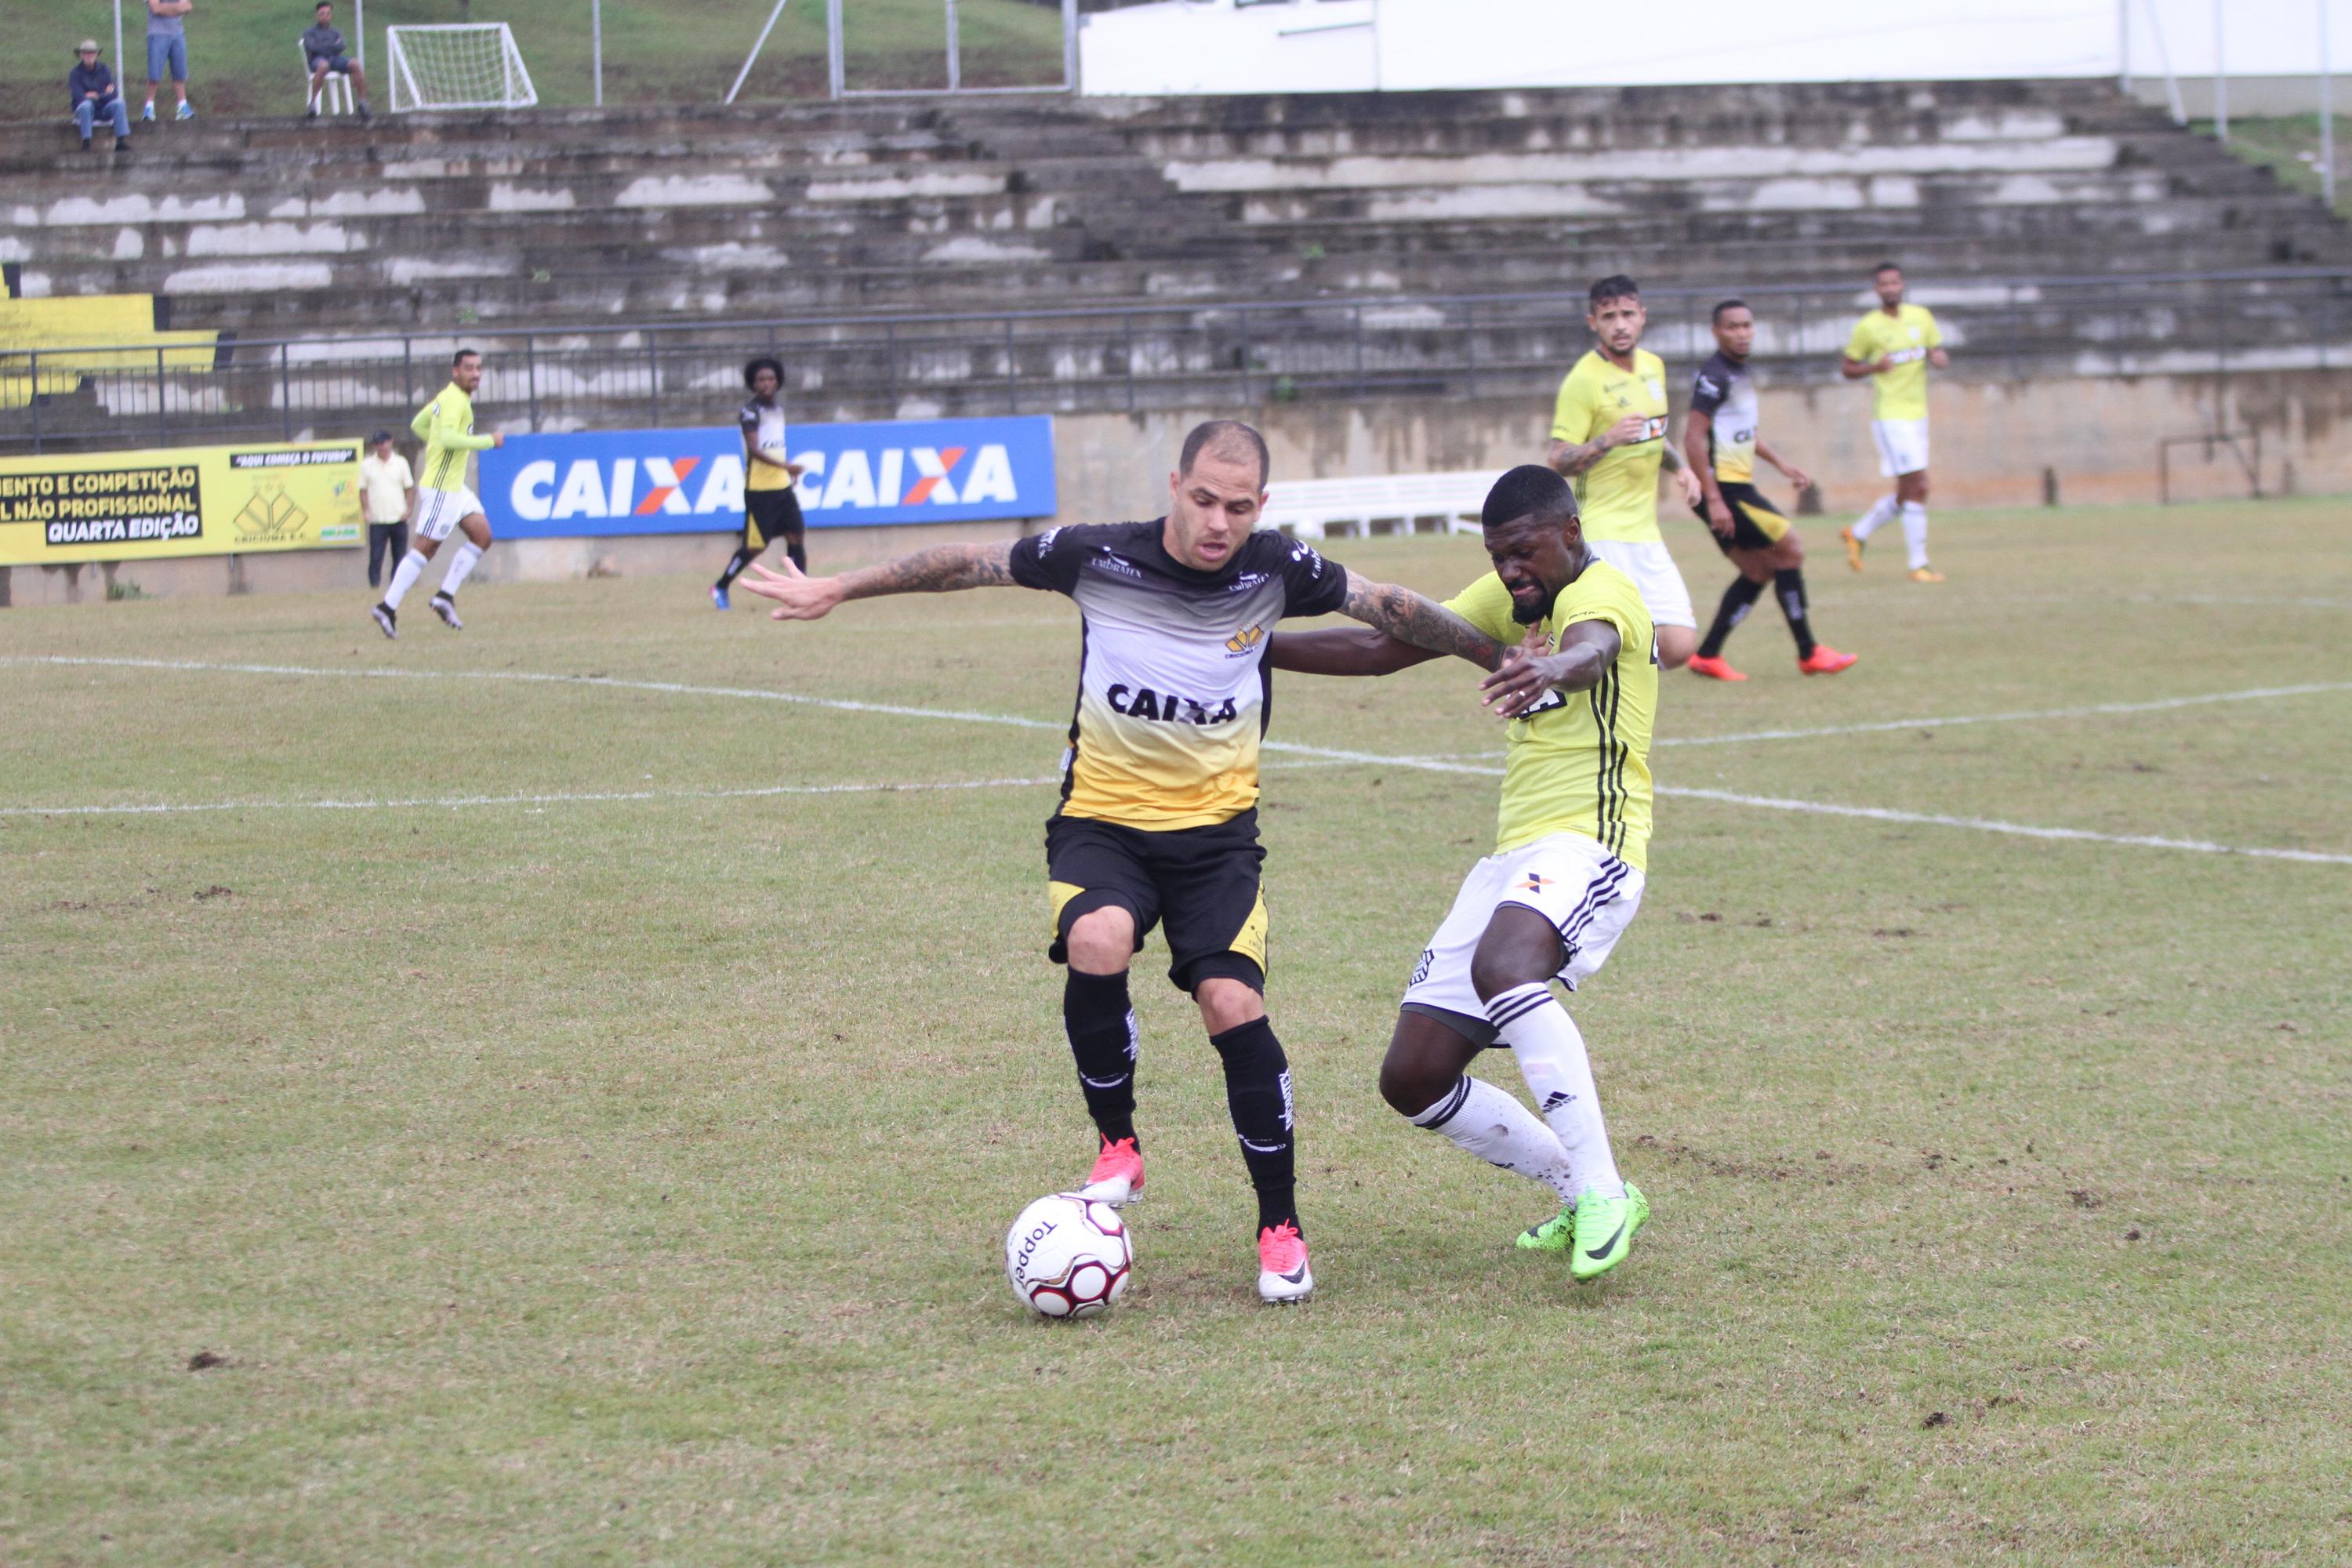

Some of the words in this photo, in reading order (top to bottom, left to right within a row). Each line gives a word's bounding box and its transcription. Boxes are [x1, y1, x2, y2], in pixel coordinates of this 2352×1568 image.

[0, 476, 54, 497] ENTO
[57, 475, 70, 495] E
[73, 466, 196, 494] COMPETIÇÃO
[510, 453, 746, 521] CAIXA
[793, 444, 1018, 511] CAIXA
[14, 497, 55, 521] NÃO
[59, 492, 197, 518] PROFISSIONAL
[48, 517, 126, 543] QUARTA
[129, 512, 199, 541] EDIÇÃO
[1107, 684, 1237, 725] CAIXA
[1015, 1221, 1058, 1284] Topper
